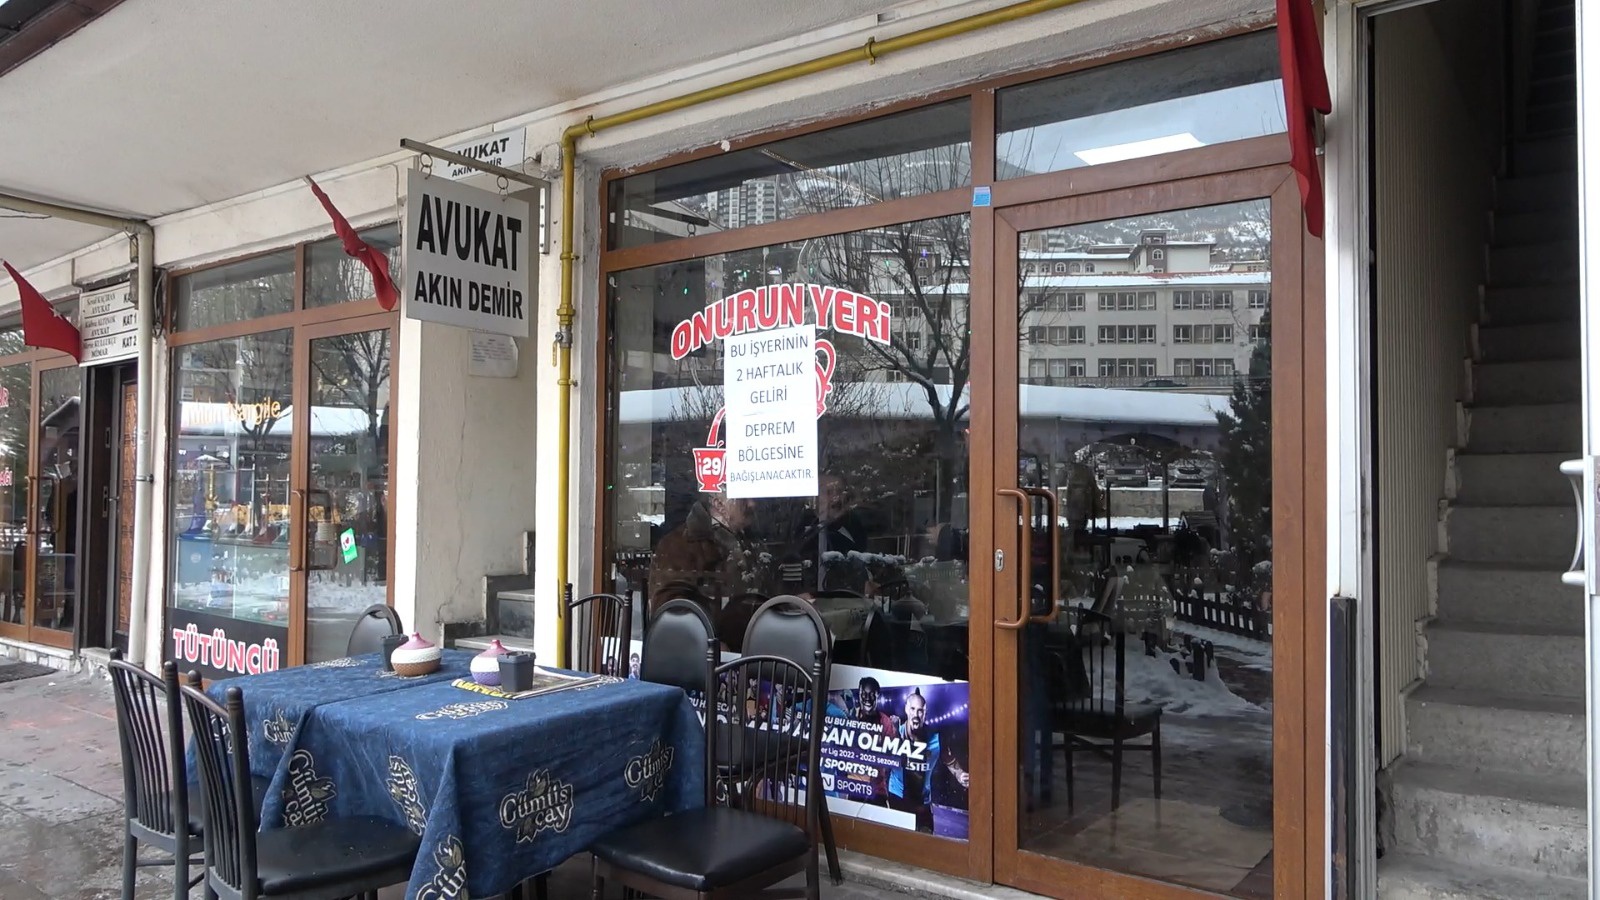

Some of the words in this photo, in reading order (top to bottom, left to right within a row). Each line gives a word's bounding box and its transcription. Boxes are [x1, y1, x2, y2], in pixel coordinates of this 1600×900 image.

[447, 137, 509, 167] VUKAT
[416, 193, 522, 271] AVUKAT
[414, 271, 462, 309] AKIN
[469, 281, 524, 320] DEMİR
[122, 315, 133, 326] KAT
[134, 313, 137, 323] 1
[671, 284, 805, 360] ONURUN
[122, 337, 132, 348] KAT
[133, 336, 137, 346] 2
[730, 343, 746, 358] BU
[749, 334, 809, 355] İŞYERİNİN
[736, 369, 743, 382] 2
[746, 362, 803, 380] HAFTALIK
[750, 385, 788, 404] GELİRİ
[745, 420, 795, 438] DEPREM
[738, 445, 804, 462] BÖLGESİNE
[702, 456, 722, 476] 29
[173, 622, 279, 676] TÜTÜNCÜ
[834, 717, 845, 726] BU
[846, 719, 883, 732] HEYECAN
[821, 726, 855, 747] SAN
[857, 732, 927, 760] OLMAZ
[828, 747, 838, 757] Lig
[839, 750, 854, 759] 2022
[860, 753, 876, 763] 2023
[877, 758, 899, 767] sezonu
[837, 779, 873, 796] SPORTS
